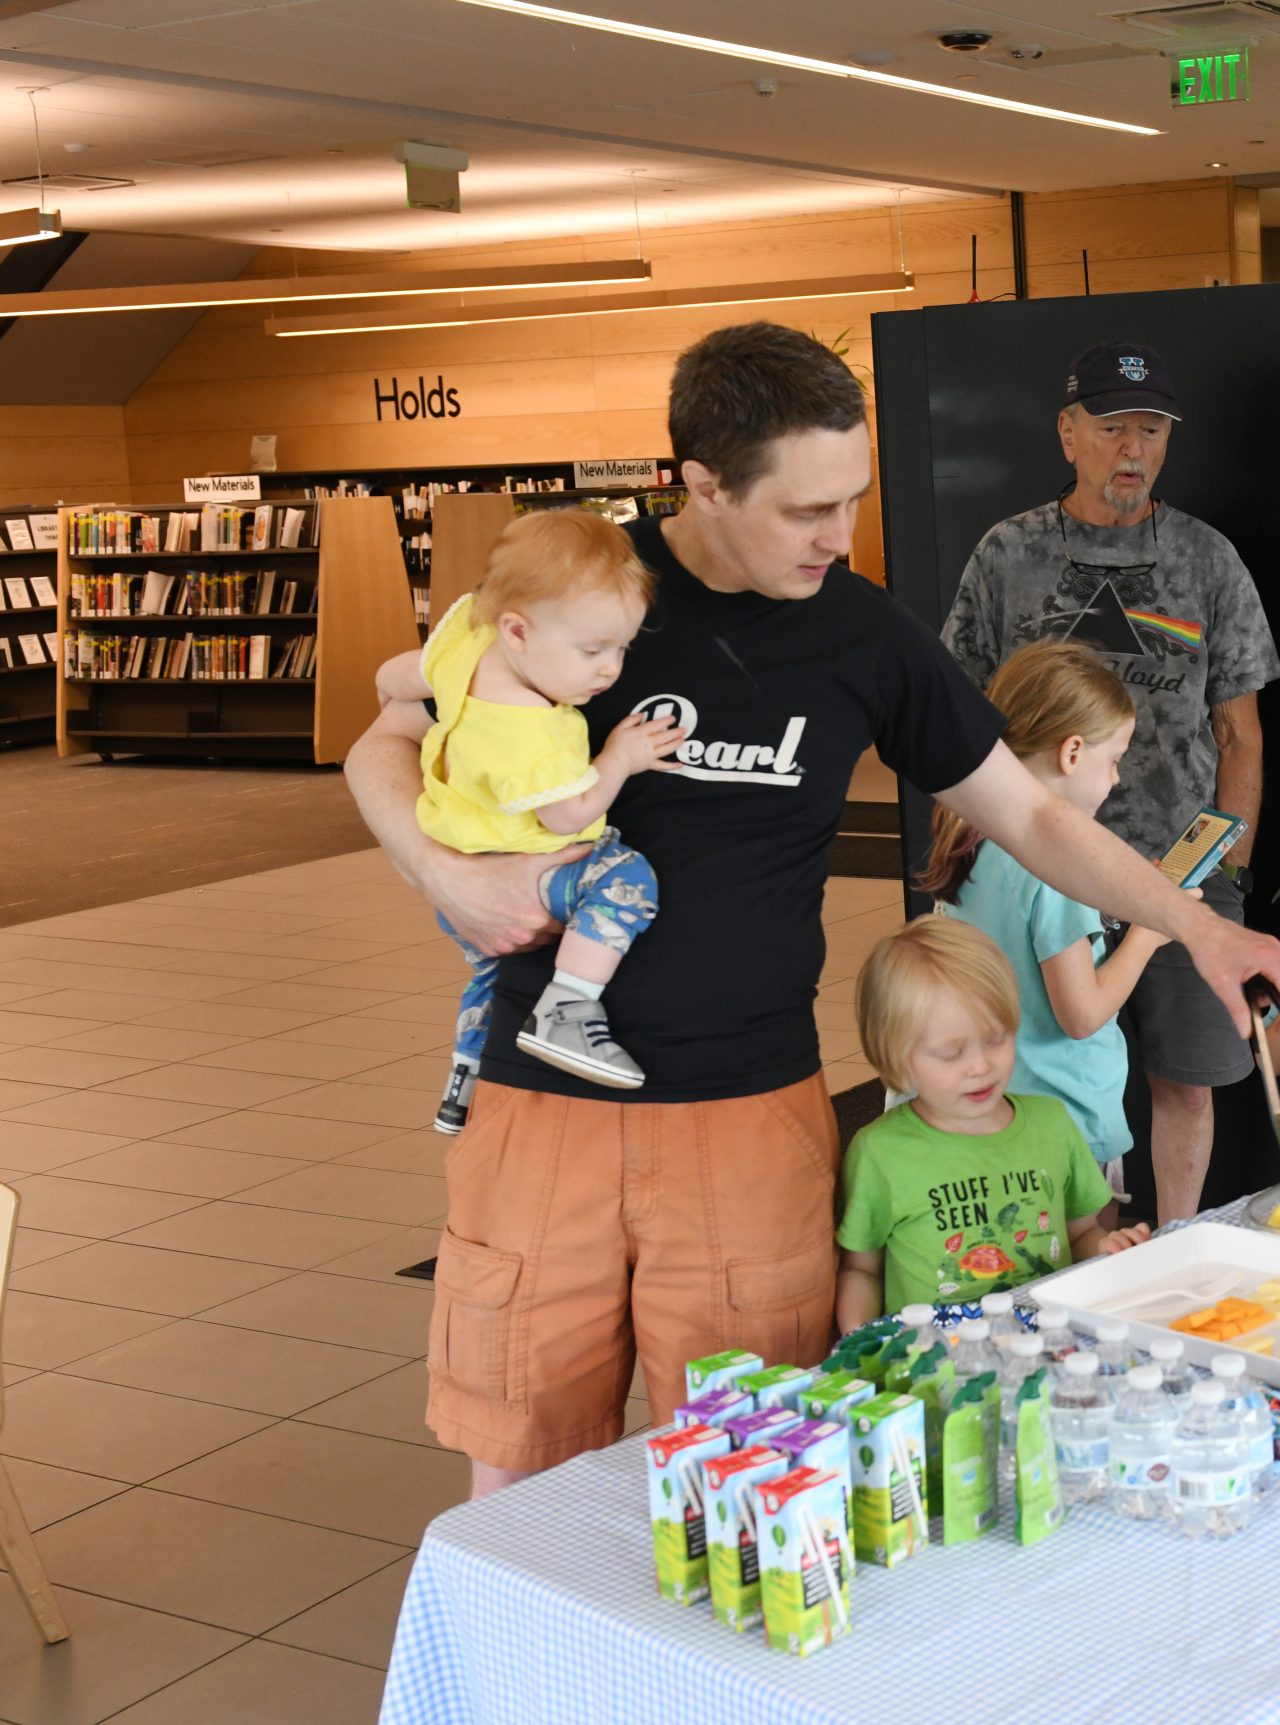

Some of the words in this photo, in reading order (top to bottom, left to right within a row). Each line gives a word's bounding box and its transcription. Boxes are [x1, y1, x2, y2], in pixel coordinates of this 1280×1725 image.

[1179, 54, 1241, 105] EXIT
[374, 375, 461, 421] Holds
[188, 478, 210, 492] New
[211, 477, 255, 492] Materials
[580, 462, 604, 477] New
[606, 460, 653, 476] Materials
[928, 1176, 989, 1209] STUFF
[1002, 1169, 1041, 1196] I'VE
[935, 1202, 989, 1232] SEEN
